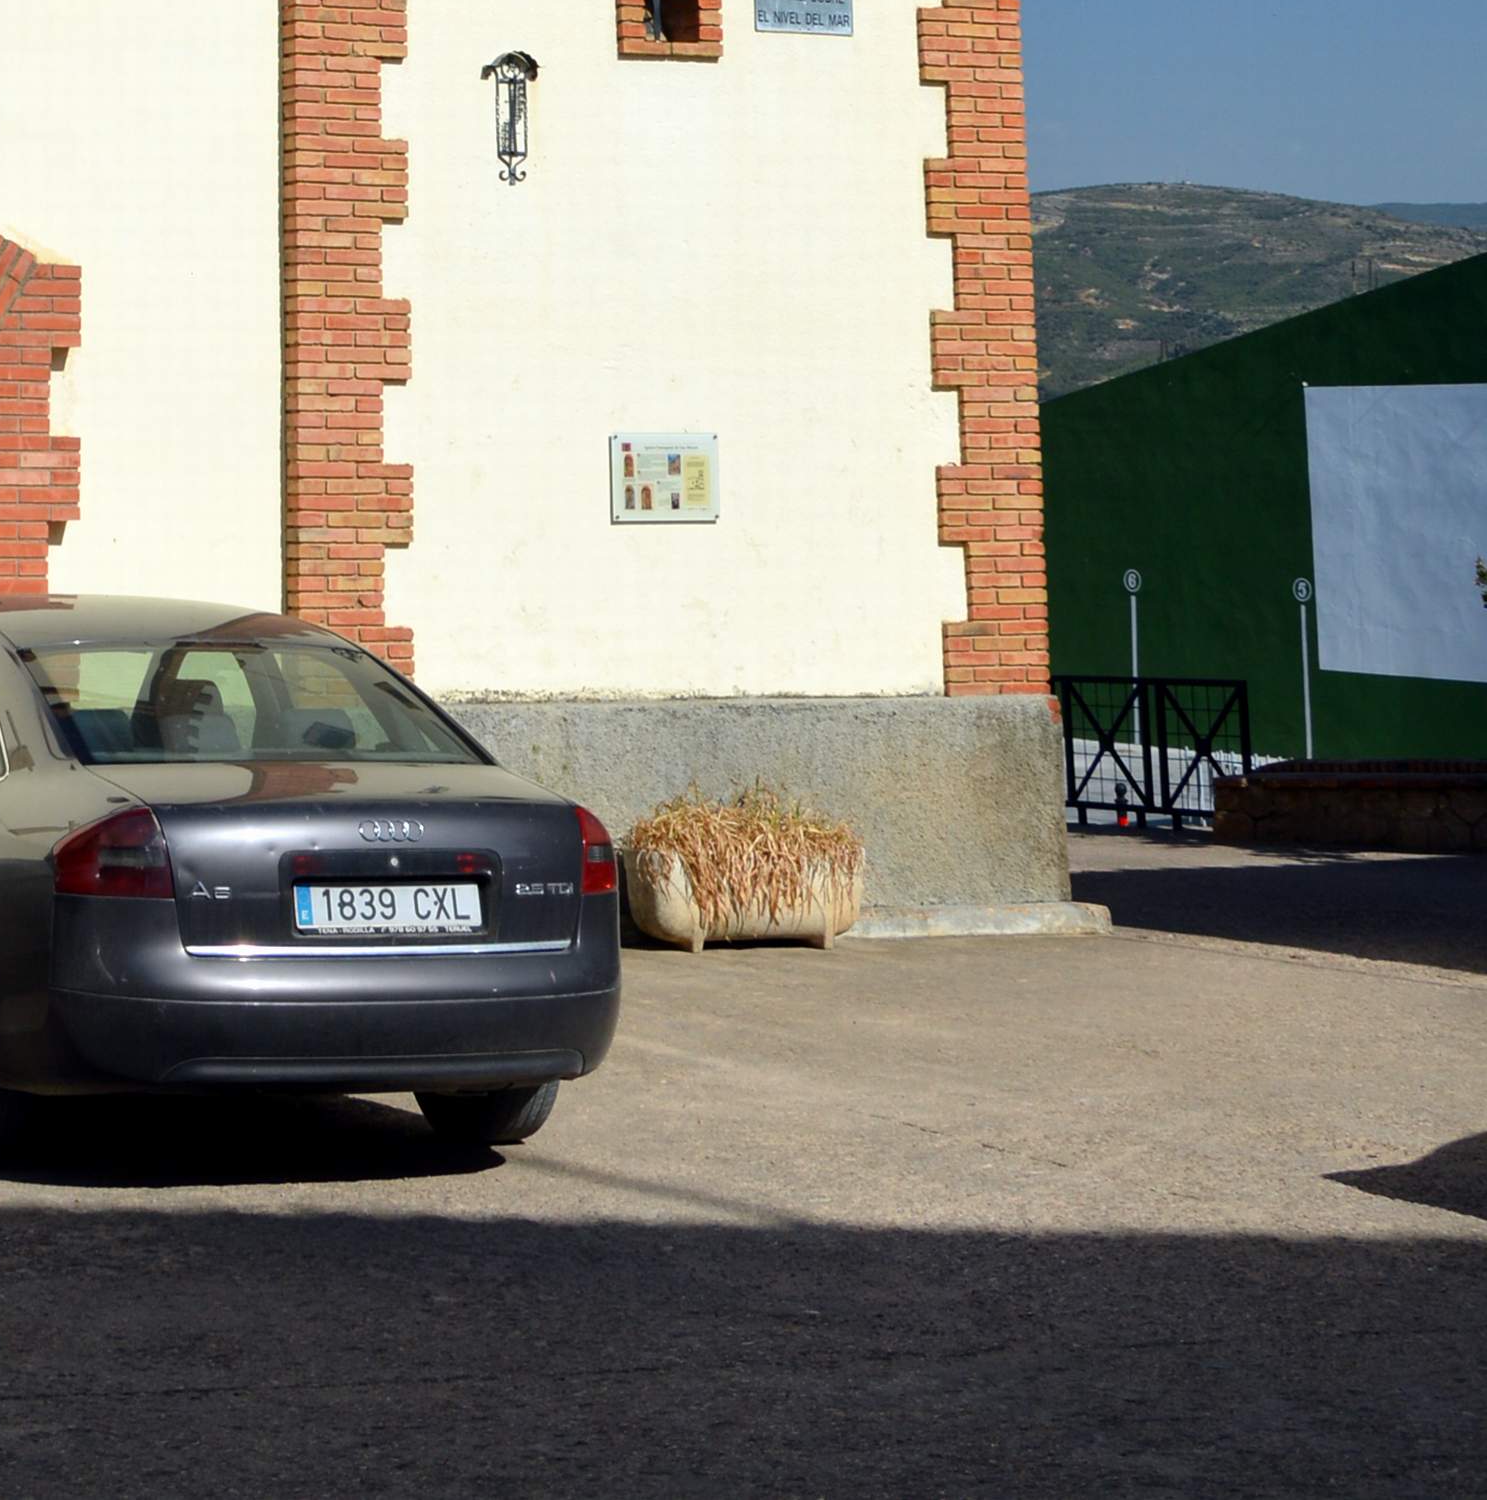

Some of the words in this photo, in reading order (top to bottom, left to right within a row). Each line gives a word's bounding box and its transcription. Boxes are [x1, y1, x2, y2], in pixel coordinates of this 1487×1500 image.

[757, 10, 769, 23] EL
[773, 10, 801, 25] NIVEL
[805, 12, 824, 26] DEL
[828, 14, 850, 27] MAR
[1127, 573, 1137, 588] 6
[1298, 582, 1307, 597] 5
[322, 888, 397, 921] 1839
[413, 888, 471, 920] CXL
[301, 910, 310, 921] E
